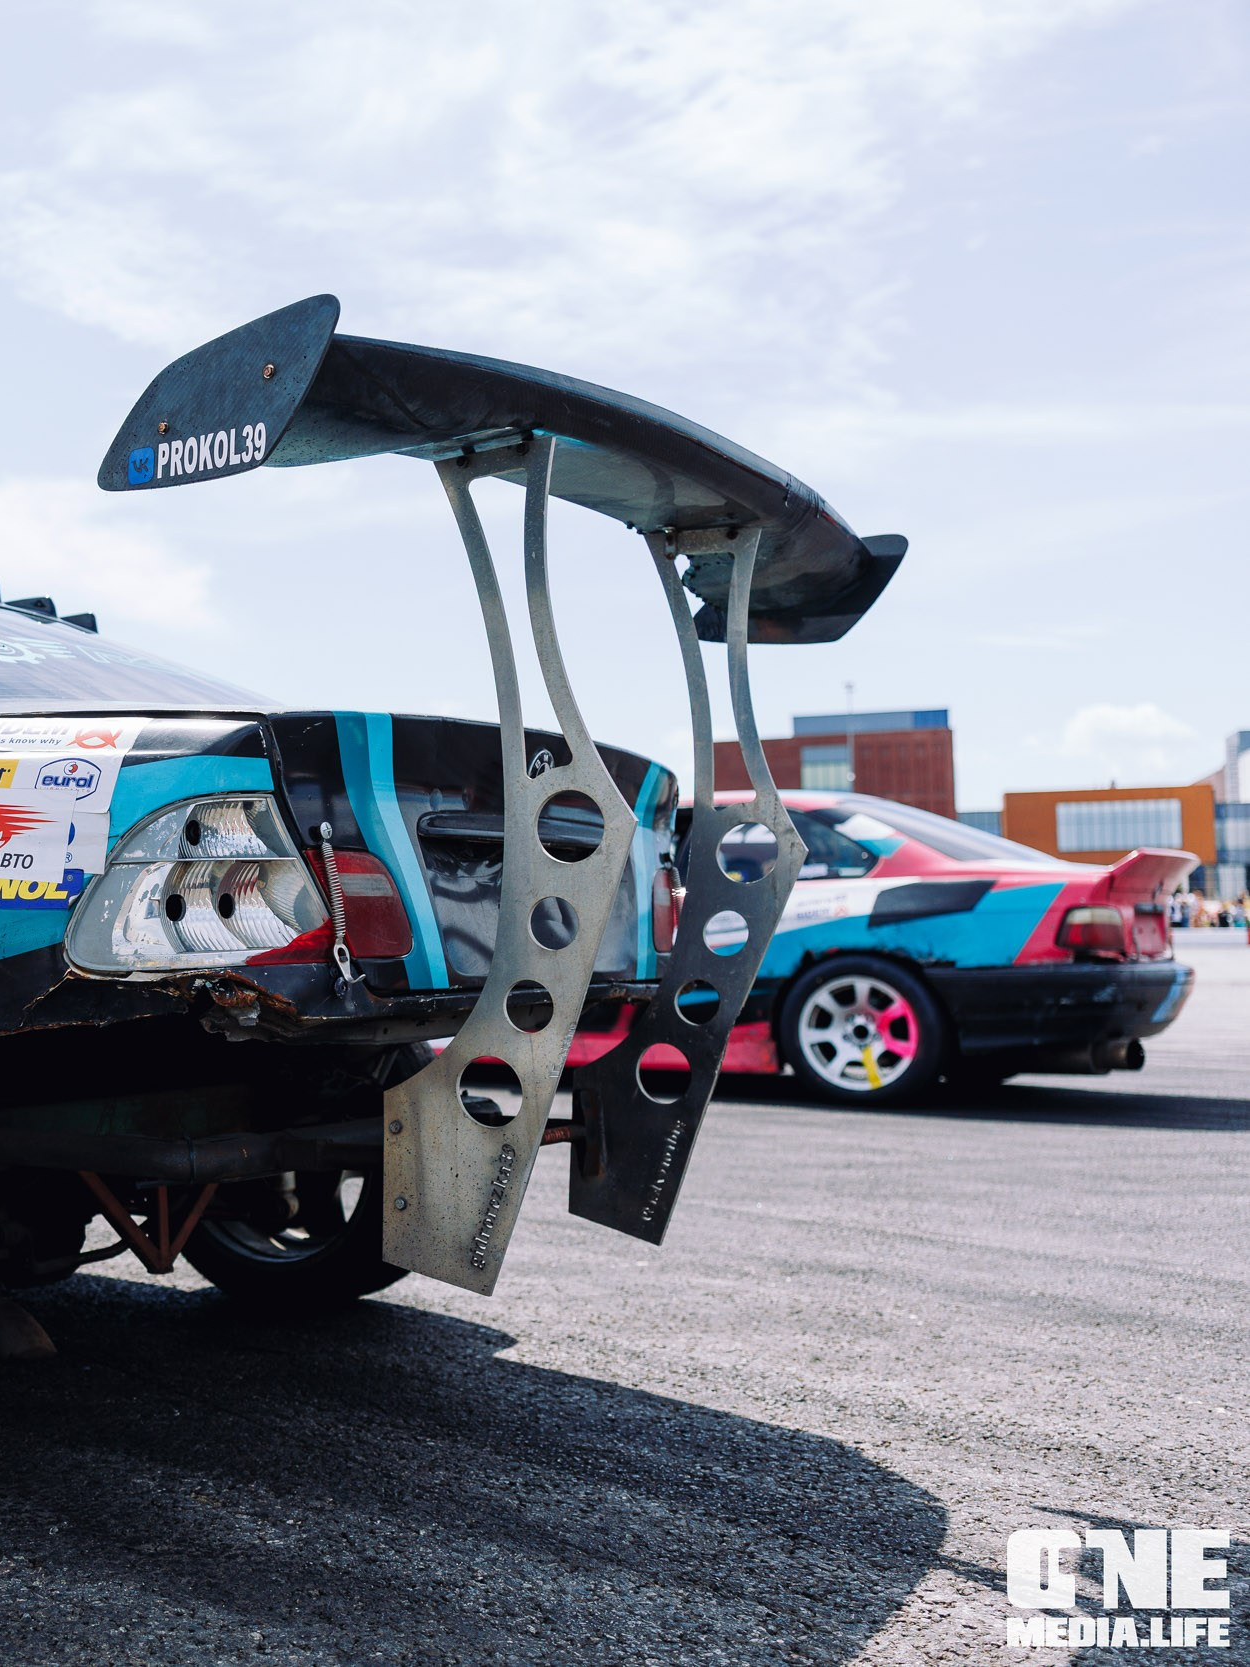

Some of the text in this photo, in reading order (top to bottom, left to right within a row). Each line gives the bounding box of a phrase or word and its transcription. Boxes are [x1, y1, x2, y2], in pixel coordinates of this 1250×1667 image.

[157, 422, 266, 479] PROKOL39
[8, 736, 38, 745] know
[41, 737, 63, 746] why
[41, 774, 94, 789] eurol
